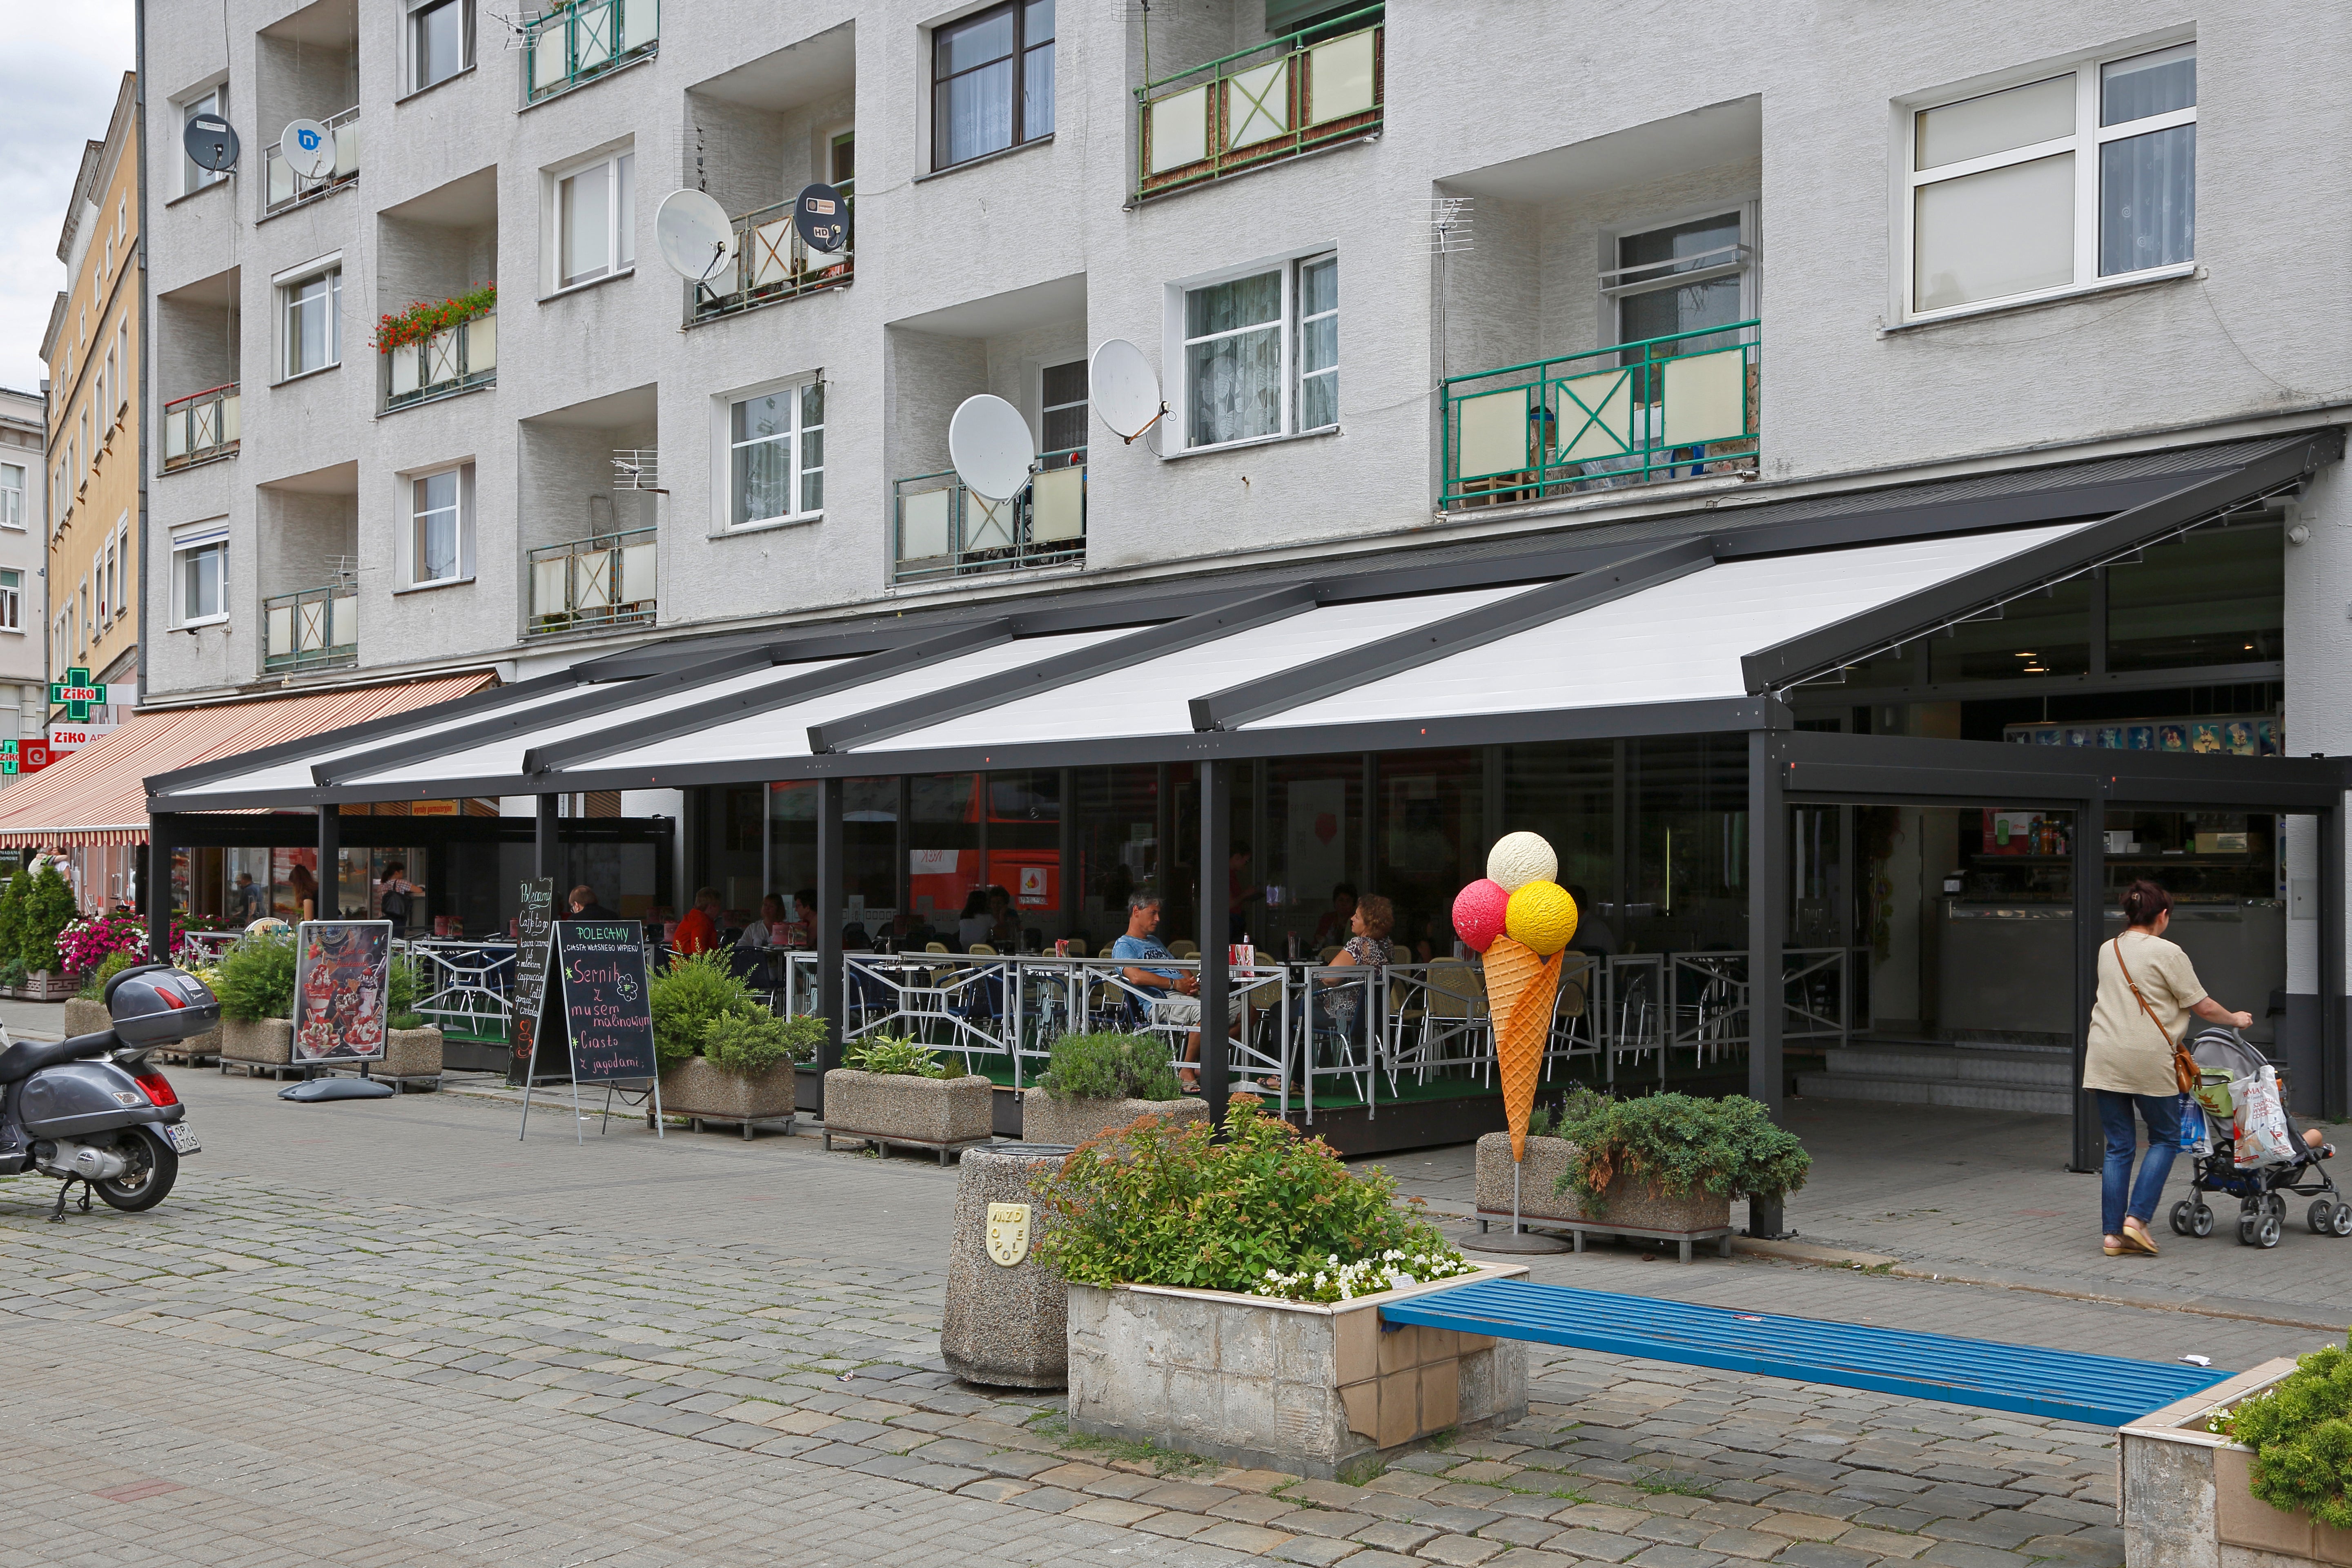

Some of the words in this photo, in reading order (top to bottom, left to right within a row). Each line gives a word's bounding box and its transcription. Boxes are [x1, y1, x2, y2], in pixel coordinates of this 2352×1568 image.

[520, 883, 551, 909] Polecamy
[576, 927, 628, 943] POLECAMY
[573, 958, 620, 983] Sernik
[572, 1004, 619, 1016] musem
[581, 1030, 618, 1049] Ciasto
[993, 1209, 1022, 1222] MZD
